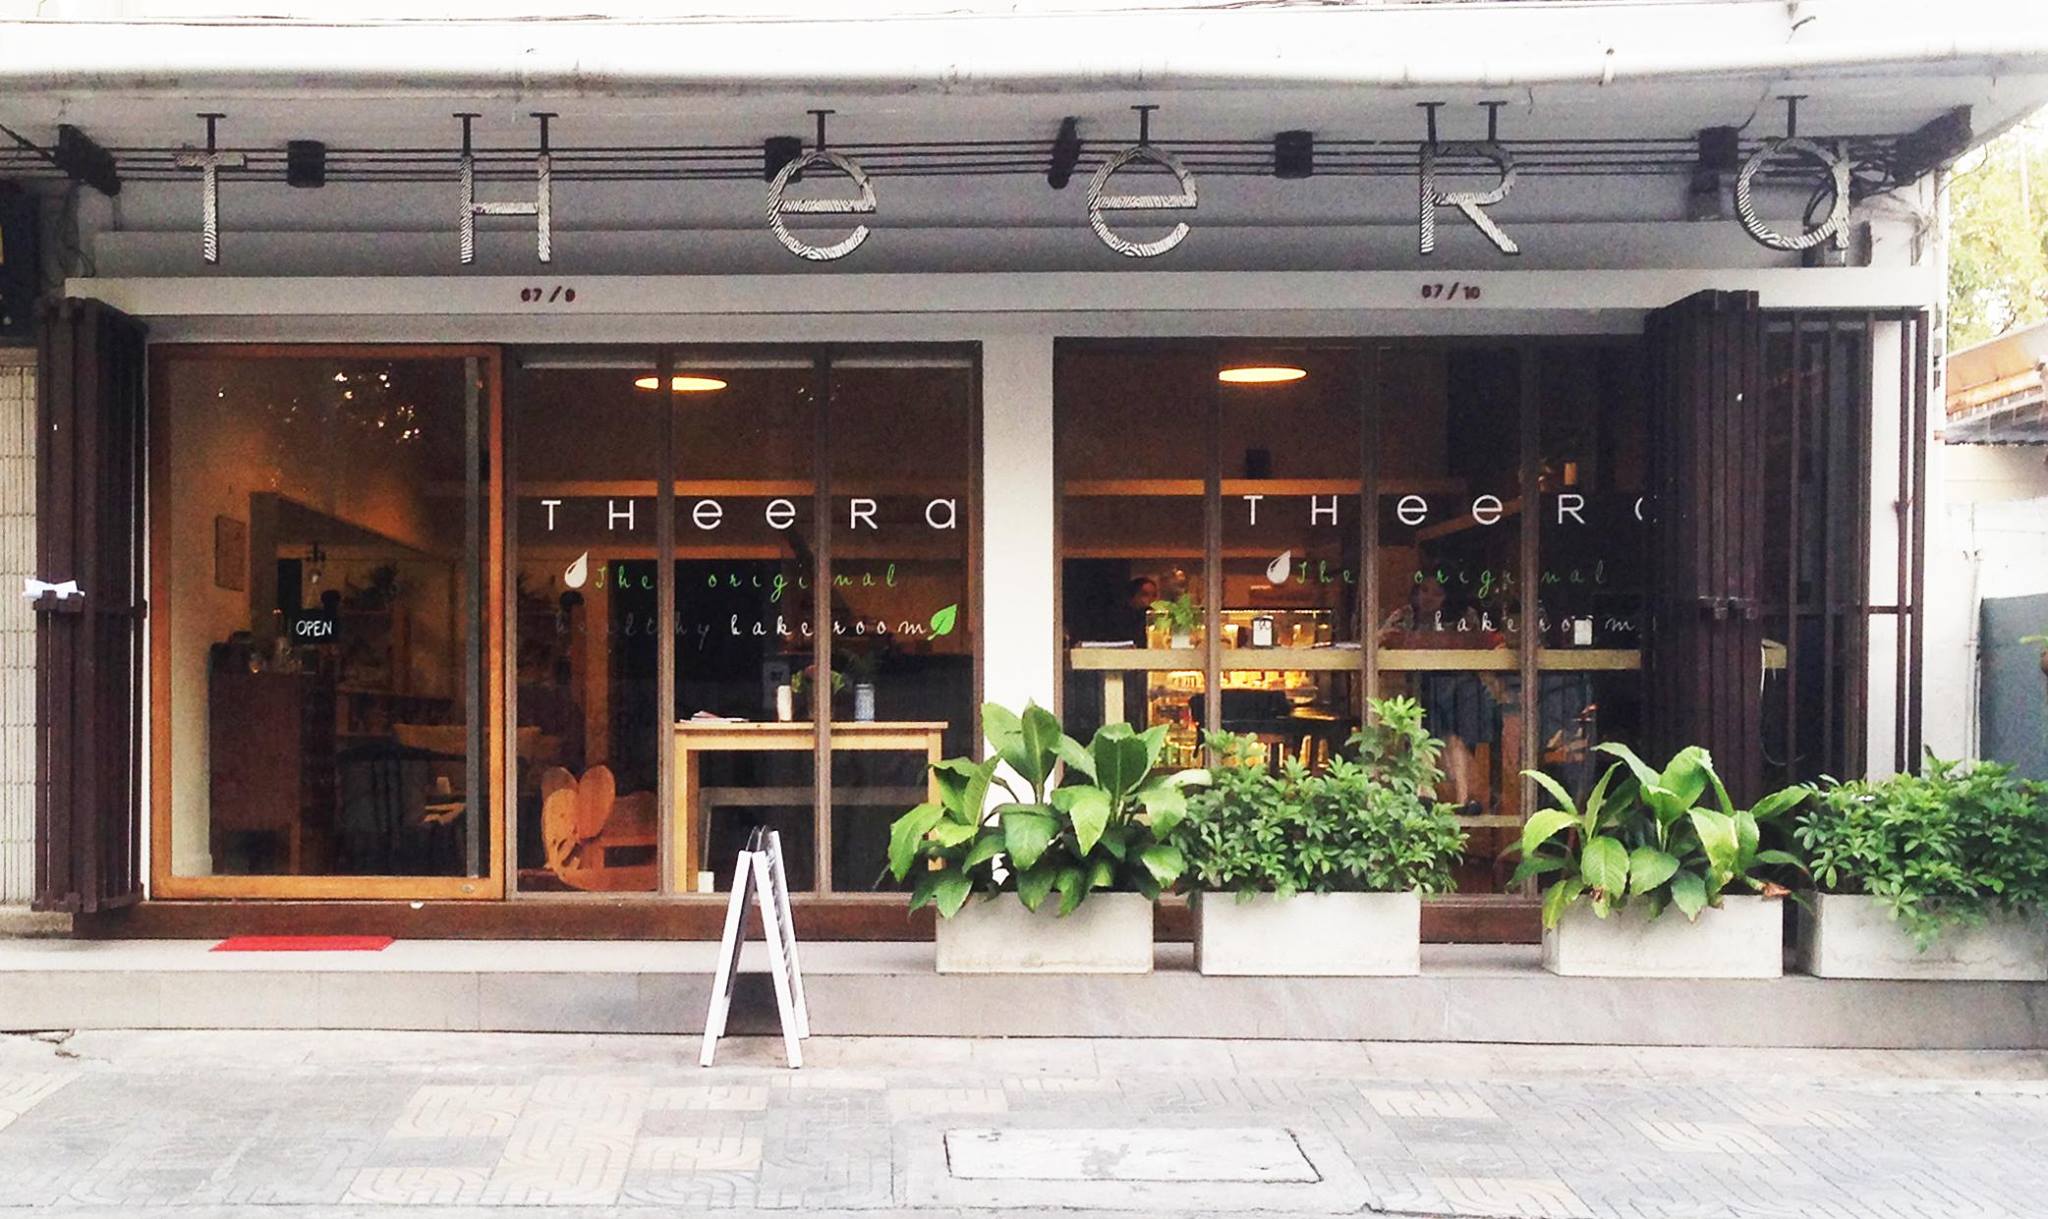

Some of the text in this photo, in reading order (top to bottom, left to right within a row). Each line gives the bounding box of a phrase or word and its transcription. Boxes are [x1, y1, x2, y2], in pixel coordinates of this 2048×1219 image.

[594, 563, 899, 602] The original
[1414, 558, 1607, 600] original
[295, 619, 333, 637] OPEN
